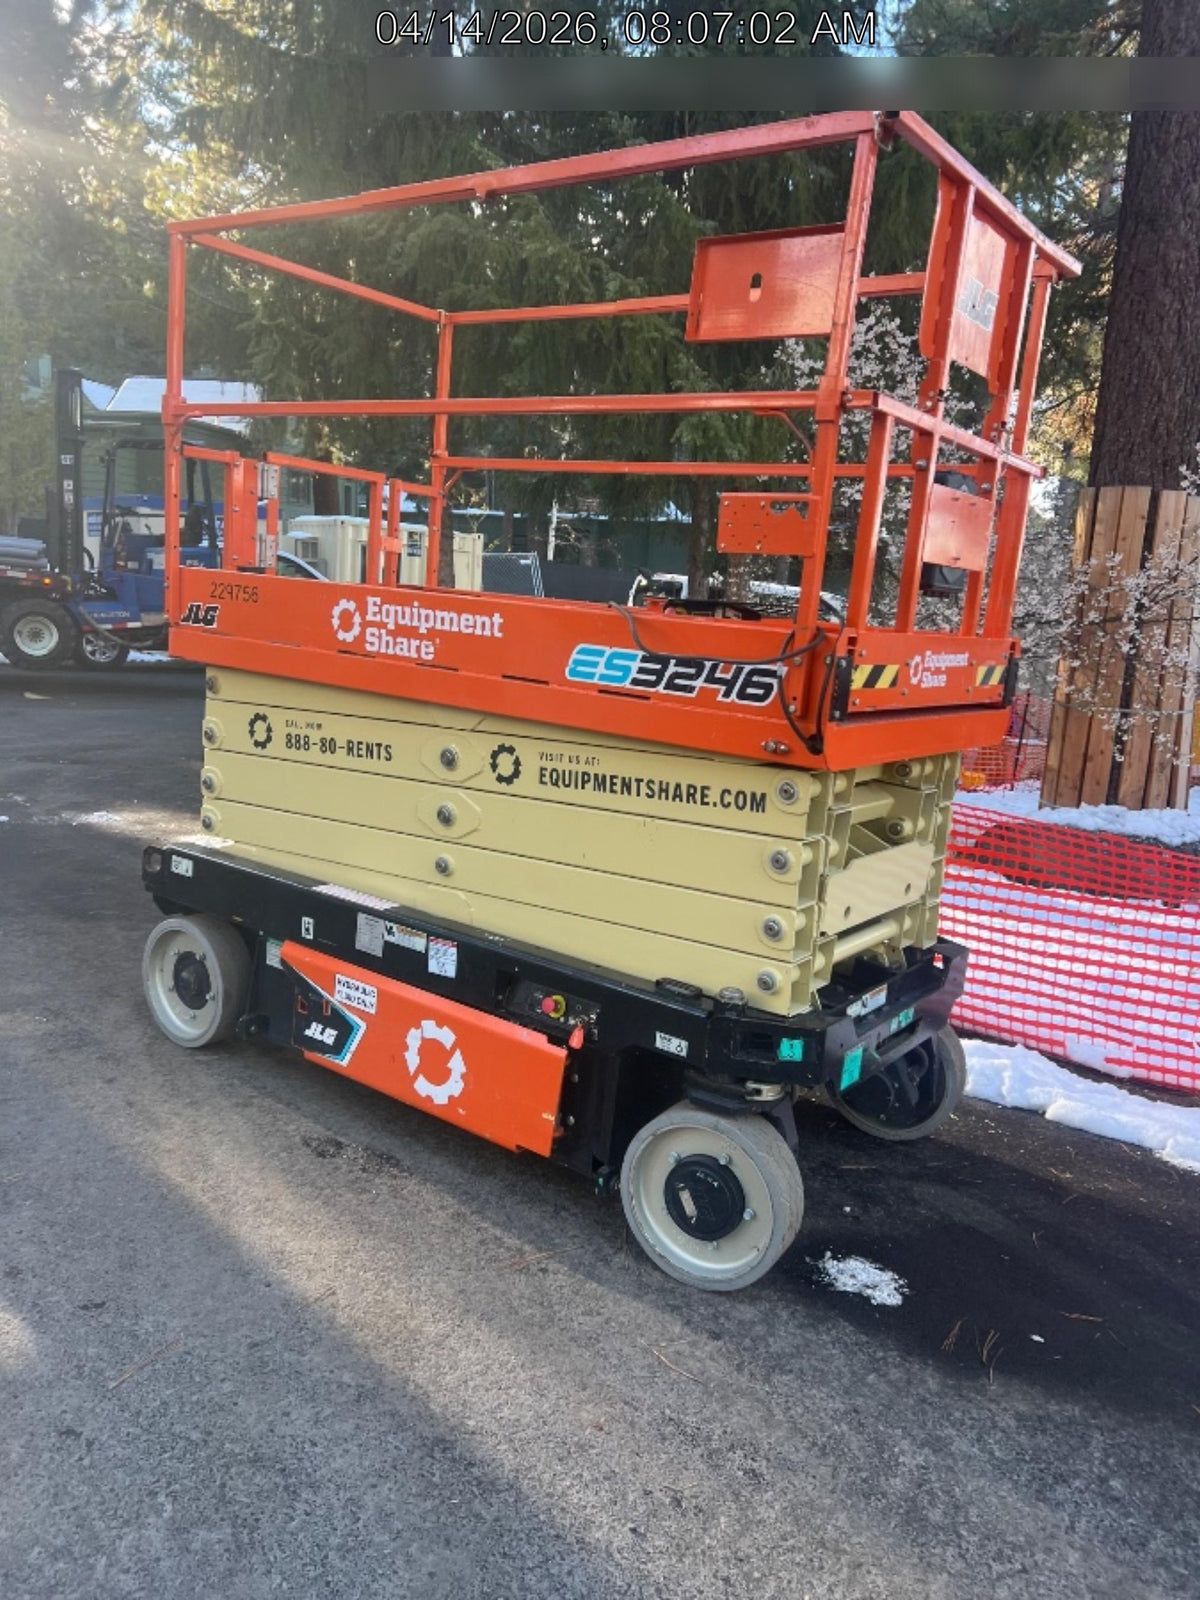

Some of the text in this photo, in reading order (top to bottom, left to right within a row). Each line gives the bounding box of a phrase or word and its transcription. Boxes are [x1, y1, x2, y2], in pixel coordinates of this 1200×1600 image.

[179, 603, 220, 628] JLG
[366, 596, 504, 638] Equipment
[365, 627, 435, 661] Share
[924, 650, 969, 671] Equipment
[566, 643, 788, 706] ES3246
[921, 671, 947, 689] Share
[285, 733, 393, 762] 888-80-RENTS
[538, 751, 600, 767] VISIT US AT:
[538, 767, 768, 814] EQUIPMENTSHARE.COM
[304, 1021, 339, 1046] JLG
